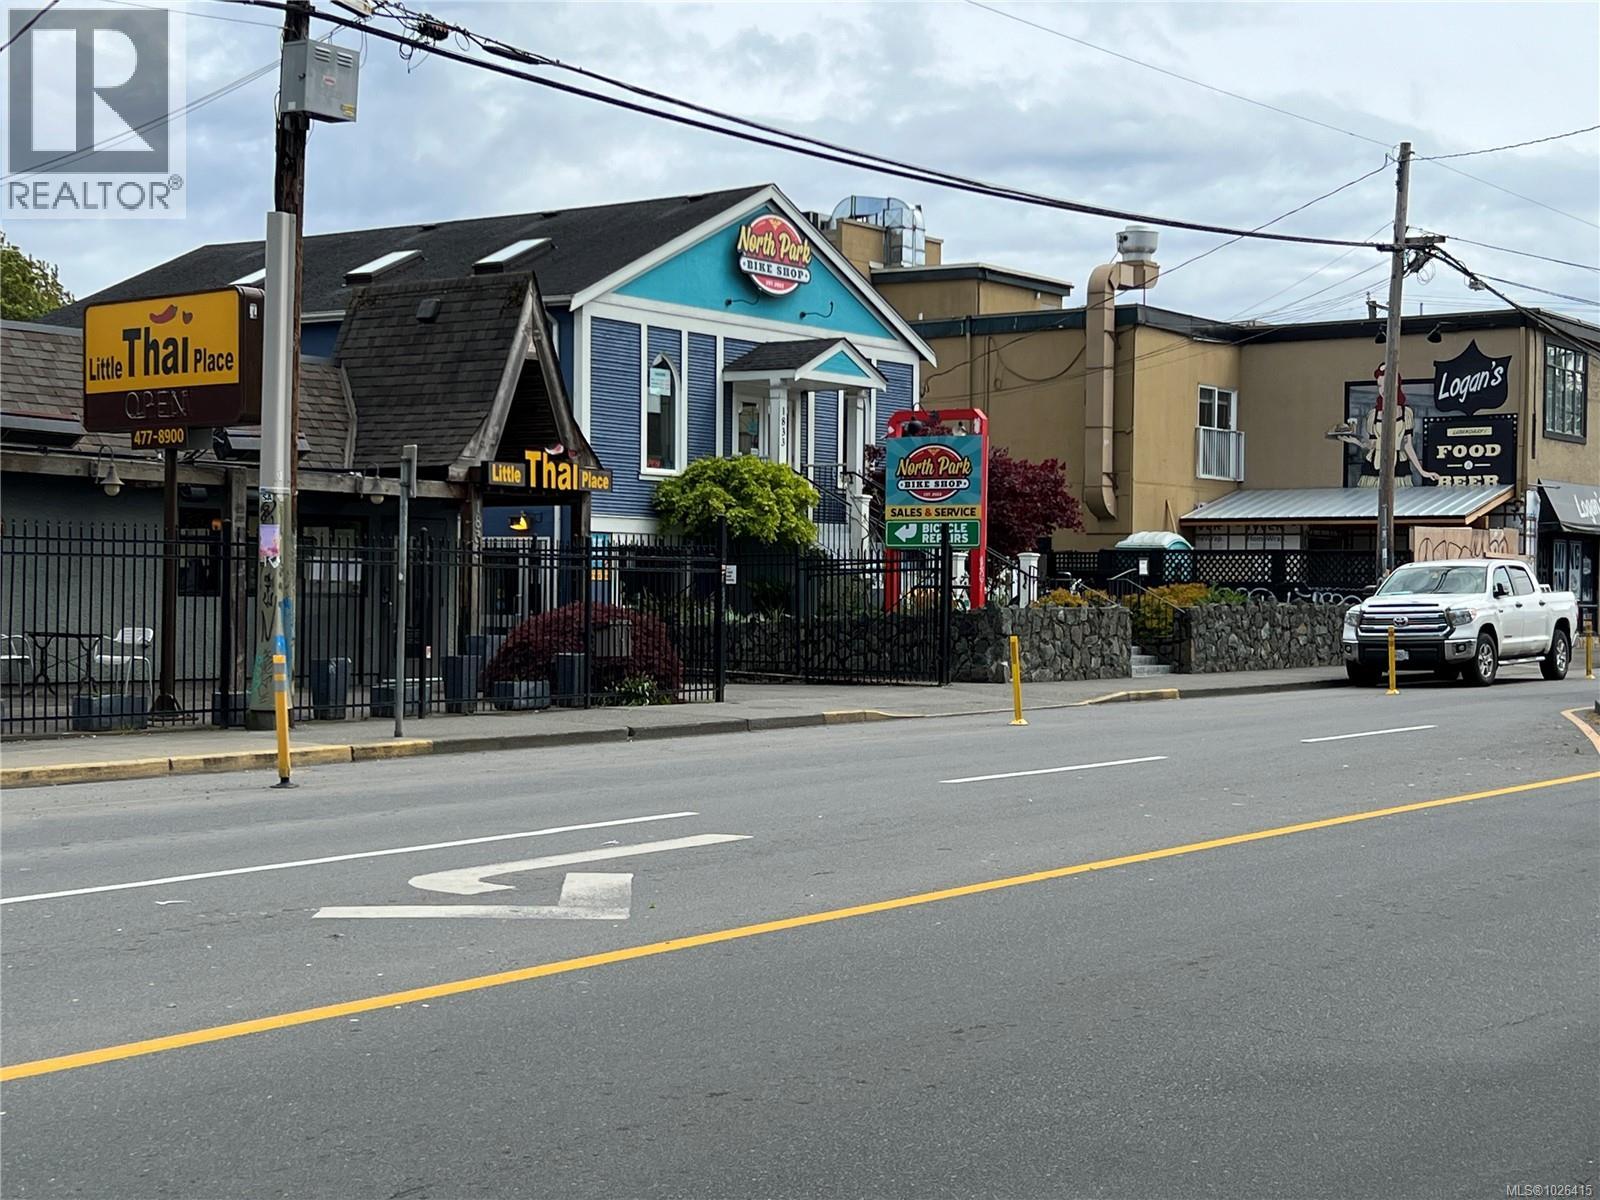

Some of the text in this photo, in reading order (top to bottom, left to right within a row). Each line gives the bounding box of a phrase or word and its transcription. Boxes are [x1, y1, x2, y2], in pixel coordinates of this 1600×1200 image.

[737, 225, 811, 264] North Park
[747, 260, 804, 279] BIKE SHOP
[89, 327, 234, 381] Little Thai Place
[1438, 361, 1504, 403] Logan's
[125, 390, 190, 420] OPEN
[134, 428, 184, 445] 477-8900
[1436, 444, 1502, 459] FOOD
[492, 450, 609, 490] Little Thai Place
[897, 456, 971, 476] North Park
[934, 480, 963, 488] SHOP
[1438, 475, 1500, 486] BEER
[891, 508, 976, 517] SALES & SERVICE
[922, 523, 968, 533] BICCLE
[922, 534, 969, 543] REPIRS
